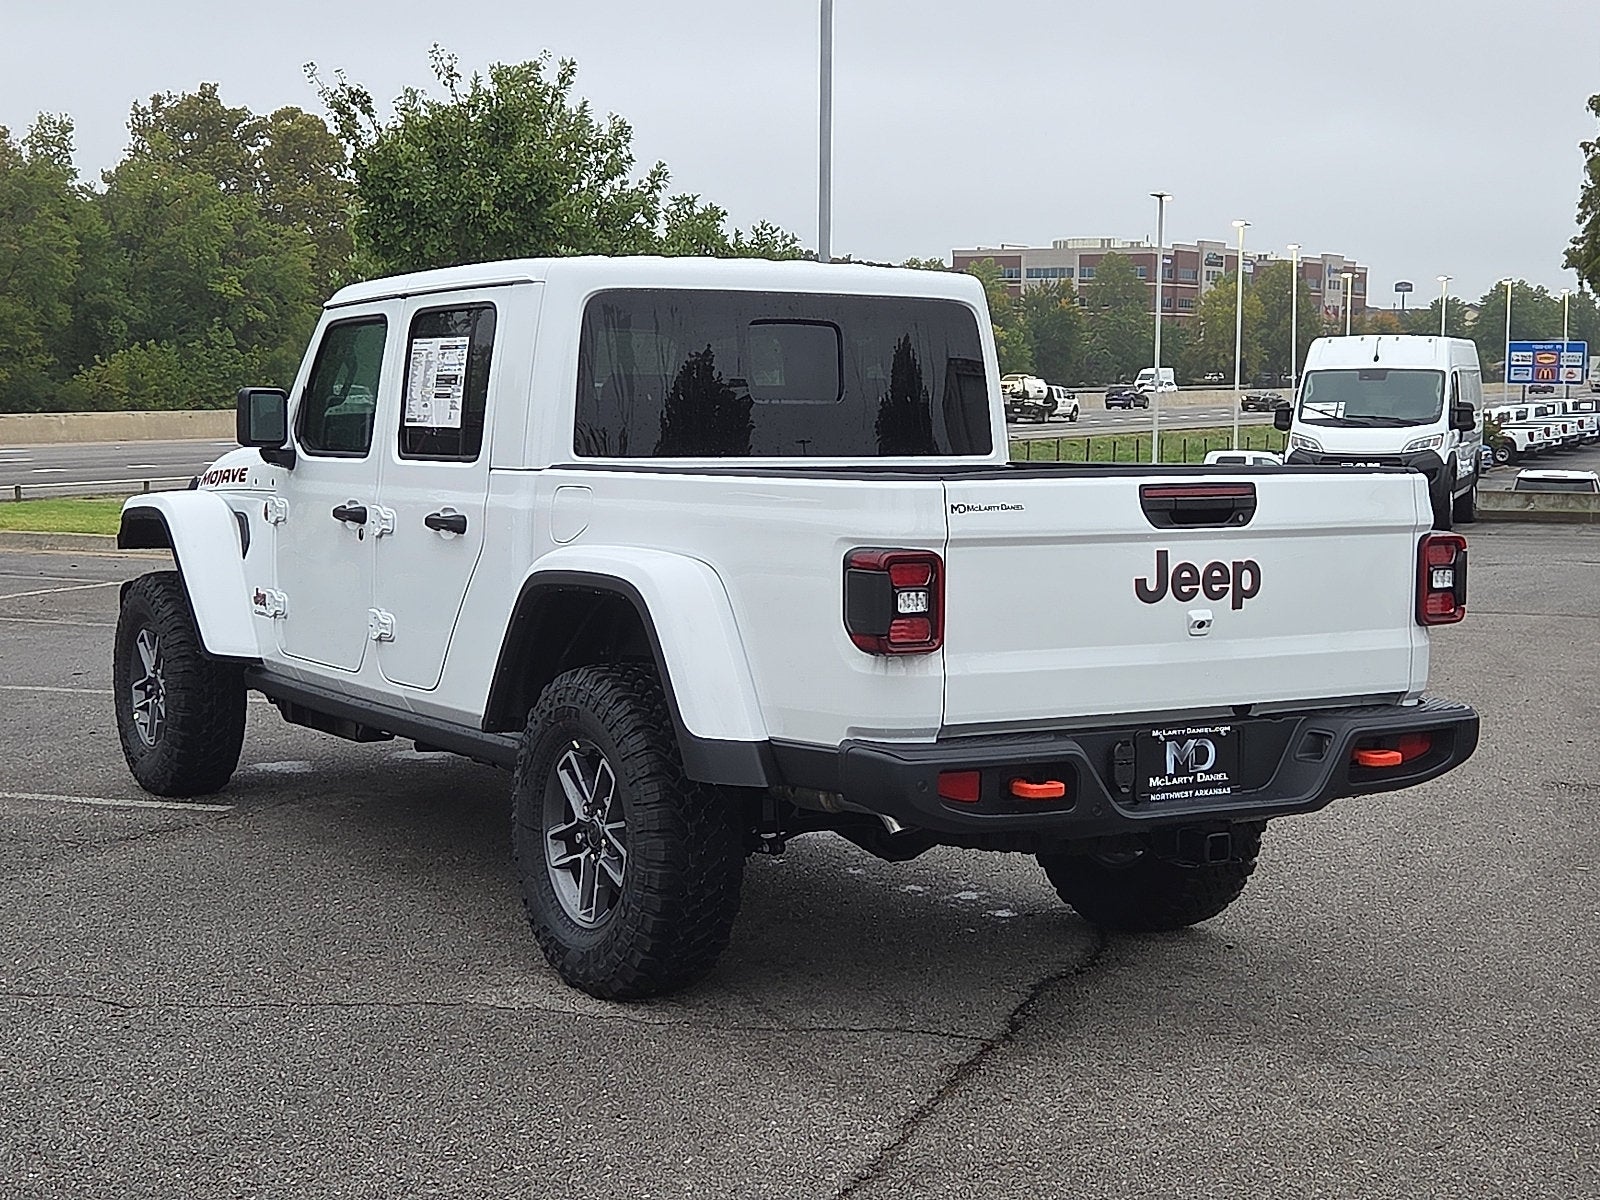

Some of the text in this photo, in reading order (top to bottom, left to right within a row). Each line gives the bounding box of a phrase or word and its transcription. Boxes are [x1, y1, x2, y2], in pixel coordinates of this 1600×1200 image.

[200, 467, 249, 487] MOJAVE
[1134, 549, 1261, 610] Jeep
[1166, 738, 1216, 774] MD
[1196, 772, 1229, 783] DANIEL
[1150, 786, 1231, 801] NORTHWEST ARKANSAS
